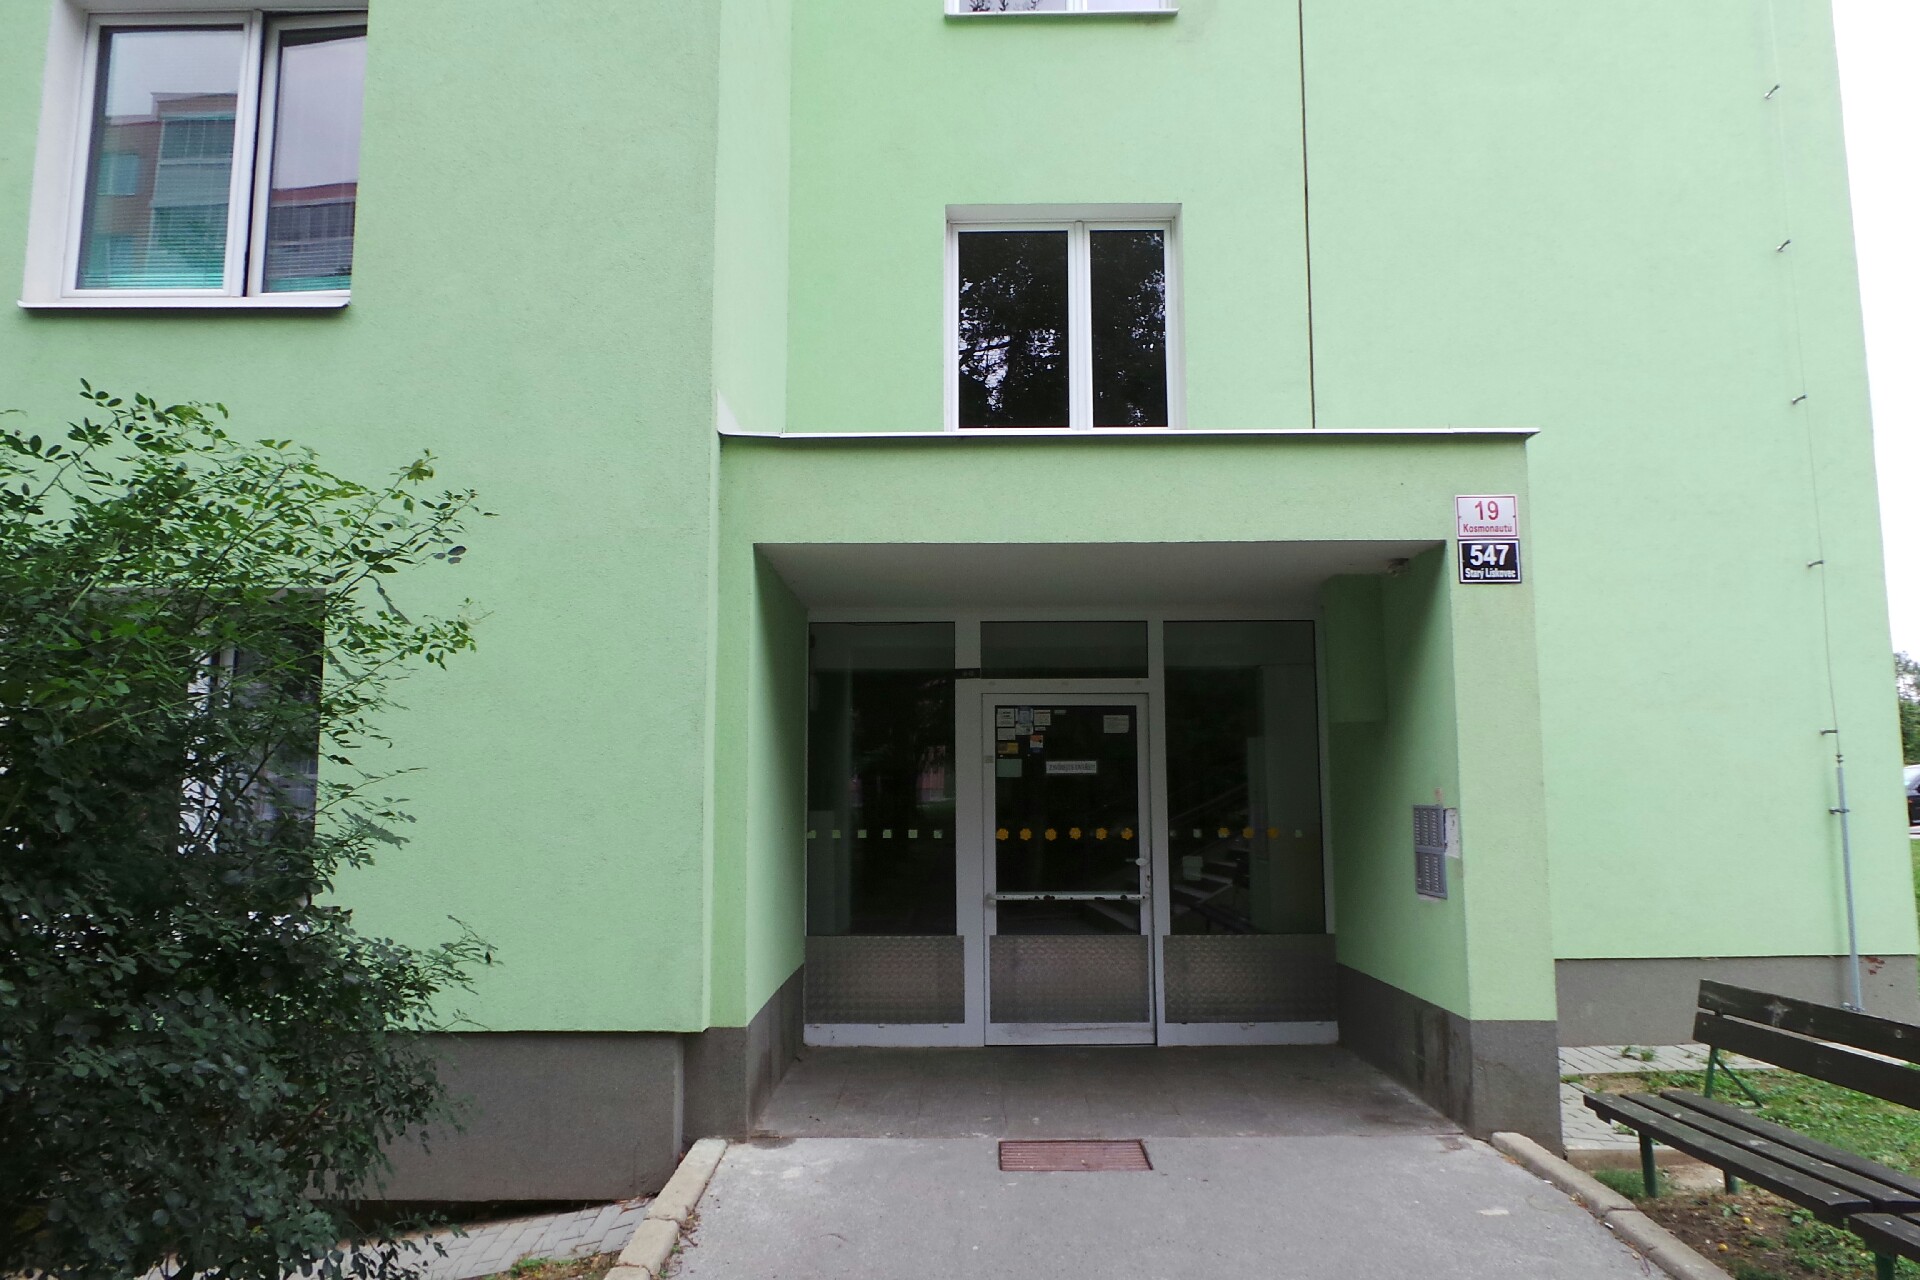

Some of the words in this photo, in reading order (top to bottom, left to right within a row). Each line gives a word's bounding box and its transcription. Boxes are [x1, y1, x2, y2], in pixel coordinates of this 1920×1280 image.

[1475, 500, 1499, 520] 19
[1470, 544, 1509, 566] 547
[1465, 567, 1484, 579] Starý
[1485, 567, 1516, 578] Lískovec
